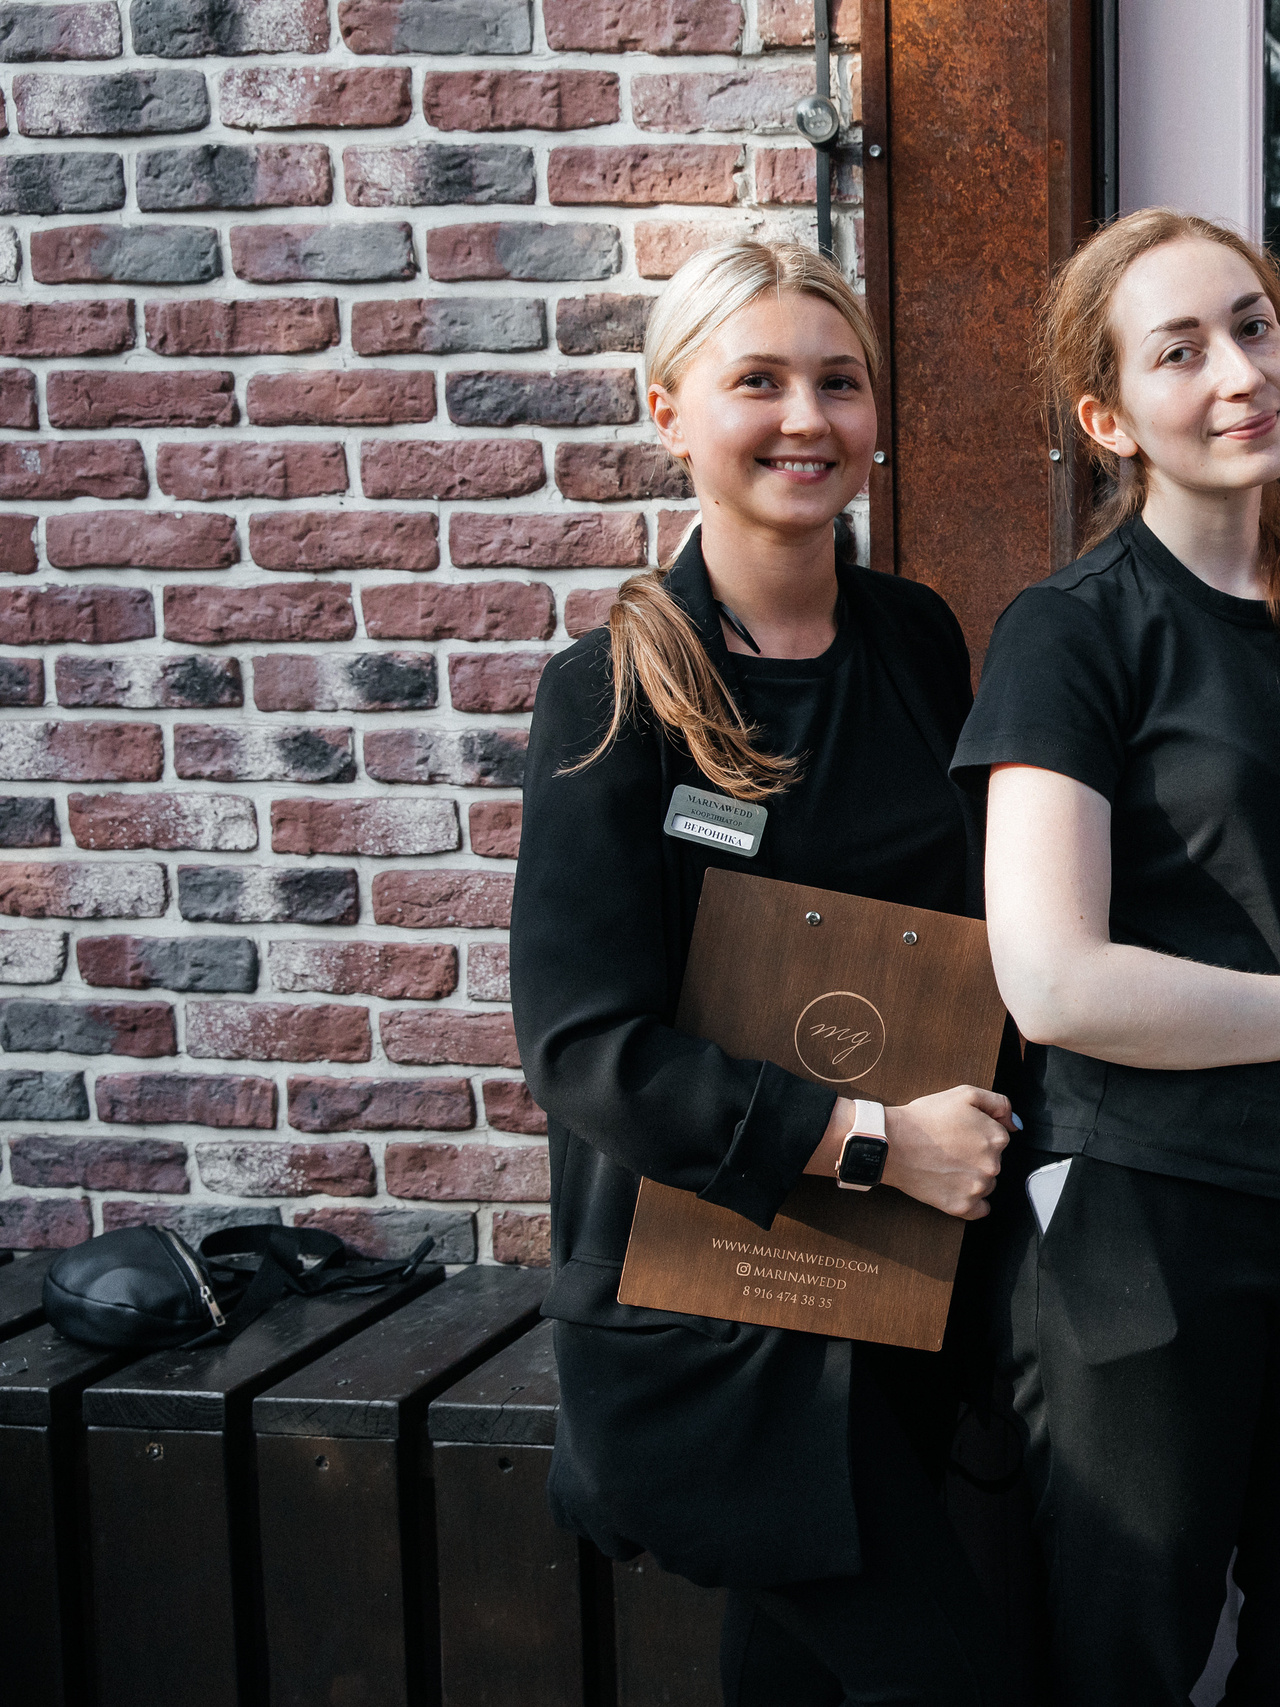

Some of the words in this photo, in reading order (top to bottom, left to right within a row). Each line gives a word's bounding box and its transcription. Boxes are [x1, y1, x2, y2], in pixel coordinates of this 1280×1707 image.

[686, 794, 753, 819] MARINAWEDD
[683, 821, 743, 847] ВЕРОНИКА
[711, 1237, 879, 1275] WWW.MARINAWEDD.COM
[753, 1266, 848, 1291] MARINAWEDD
[742, 1285, 751, 1296] 8
[754, 1287, 773, 1300] 916
[776, 1291, 798, 1304] 474
[800, 1294, 816, 1307] 38
[818, 1297, 833, 1309] 35
